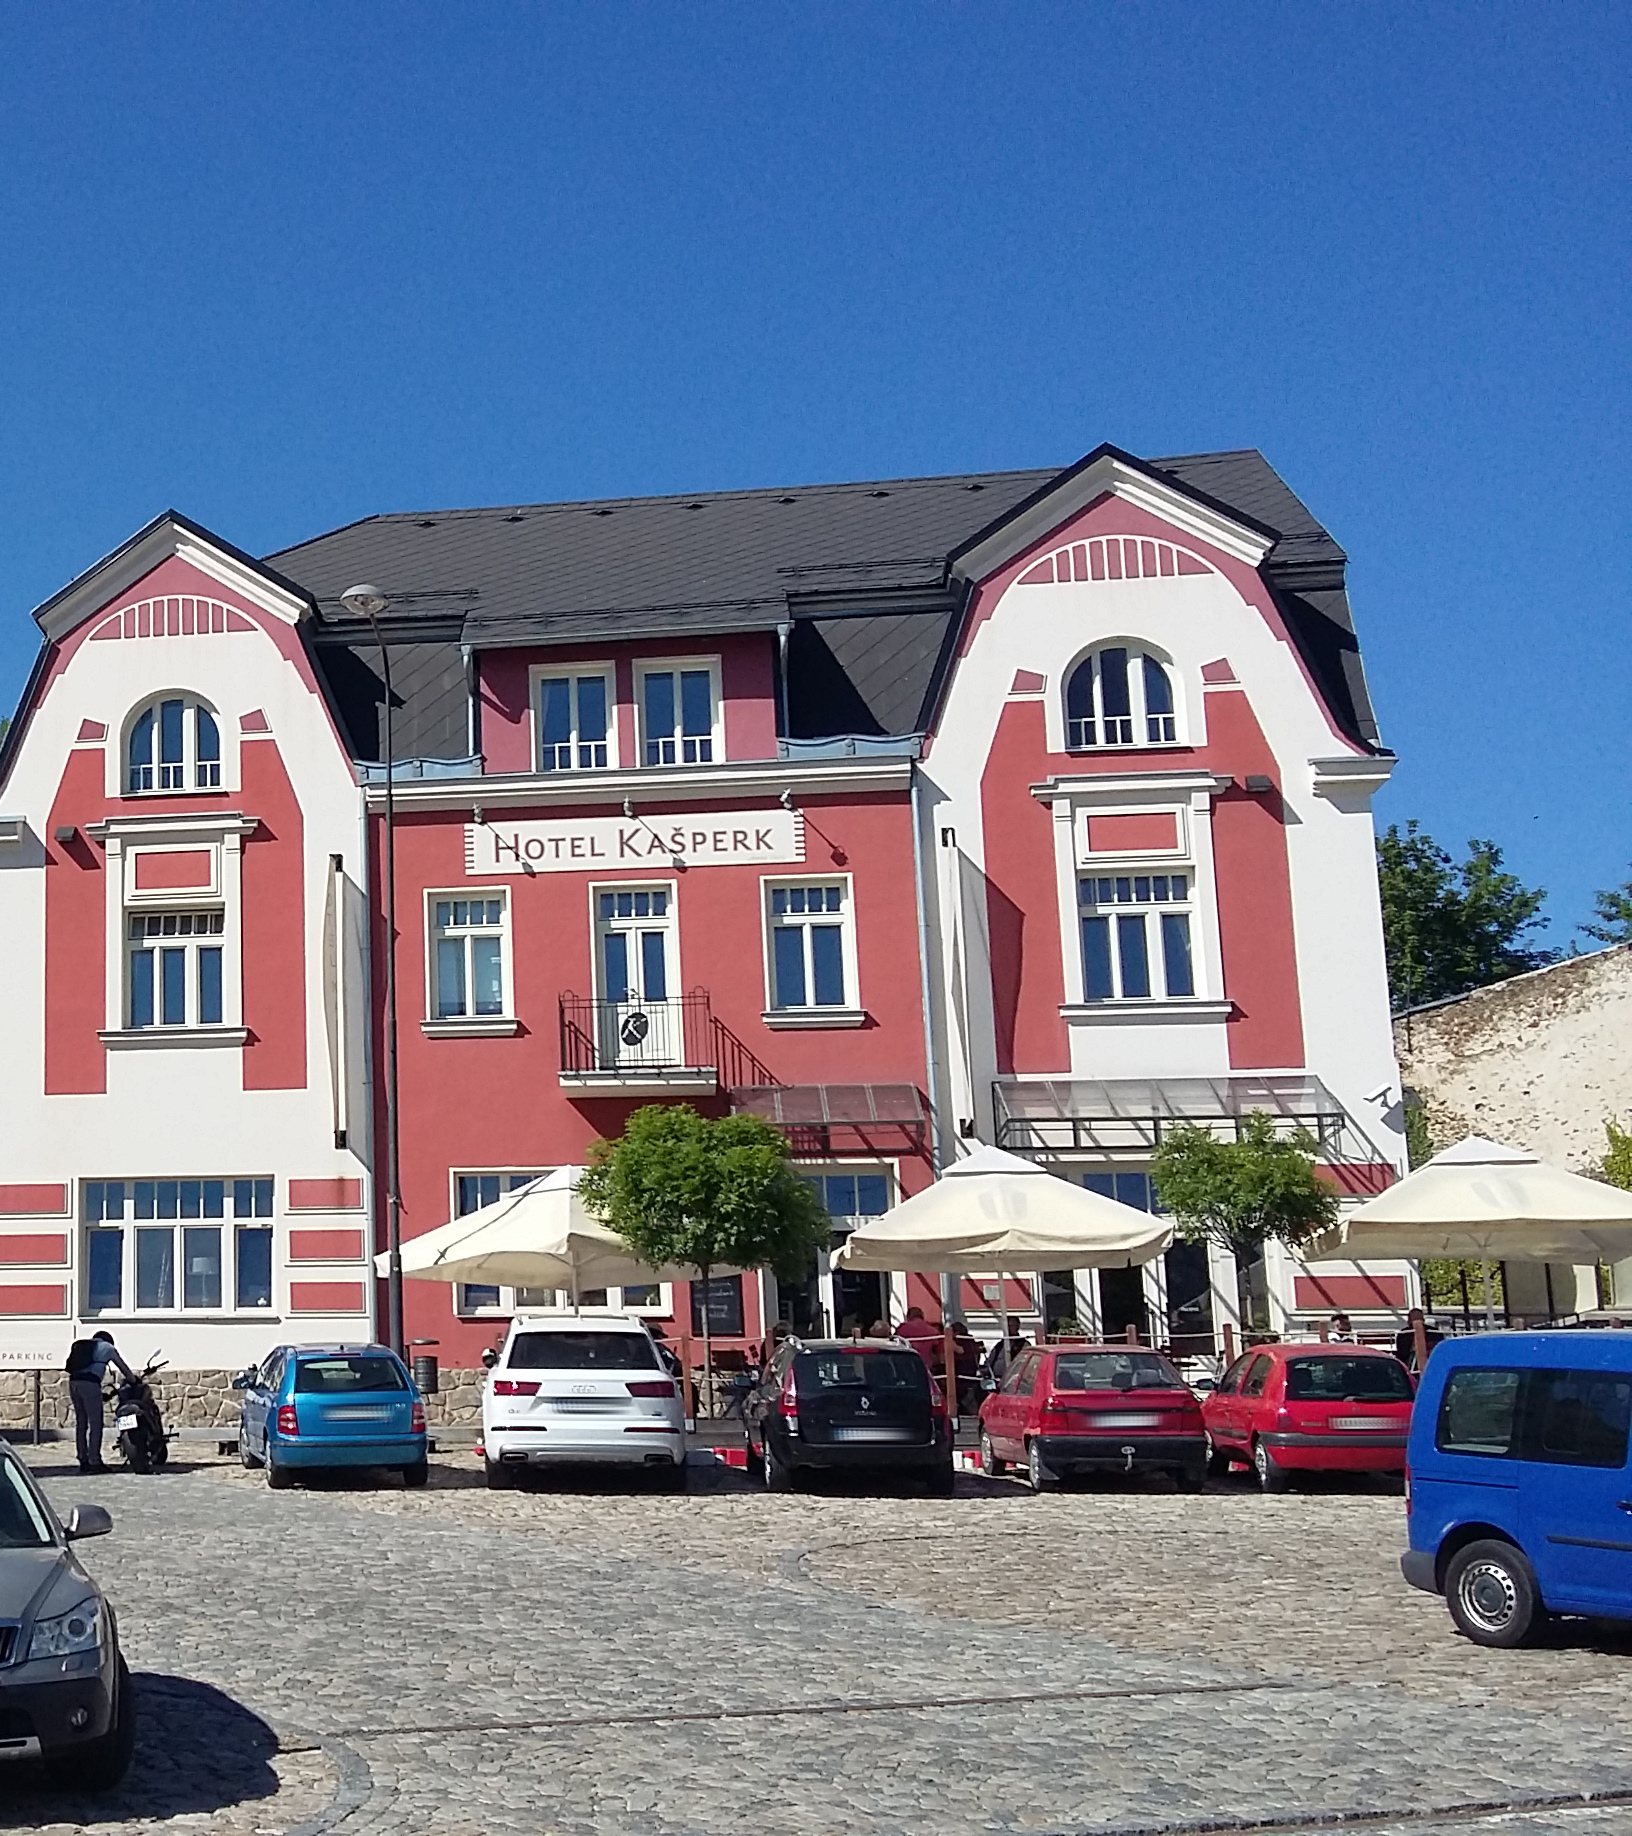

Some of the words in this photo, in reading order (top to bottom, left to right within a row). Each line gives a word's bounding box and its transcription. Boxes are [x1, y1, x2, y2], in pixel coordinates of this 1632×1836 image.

[494, 833, 605, 863] HOTEL
[618, 827, 775, 858] KAŠPERK
[1, 1352, 53, 1361] PARKING
